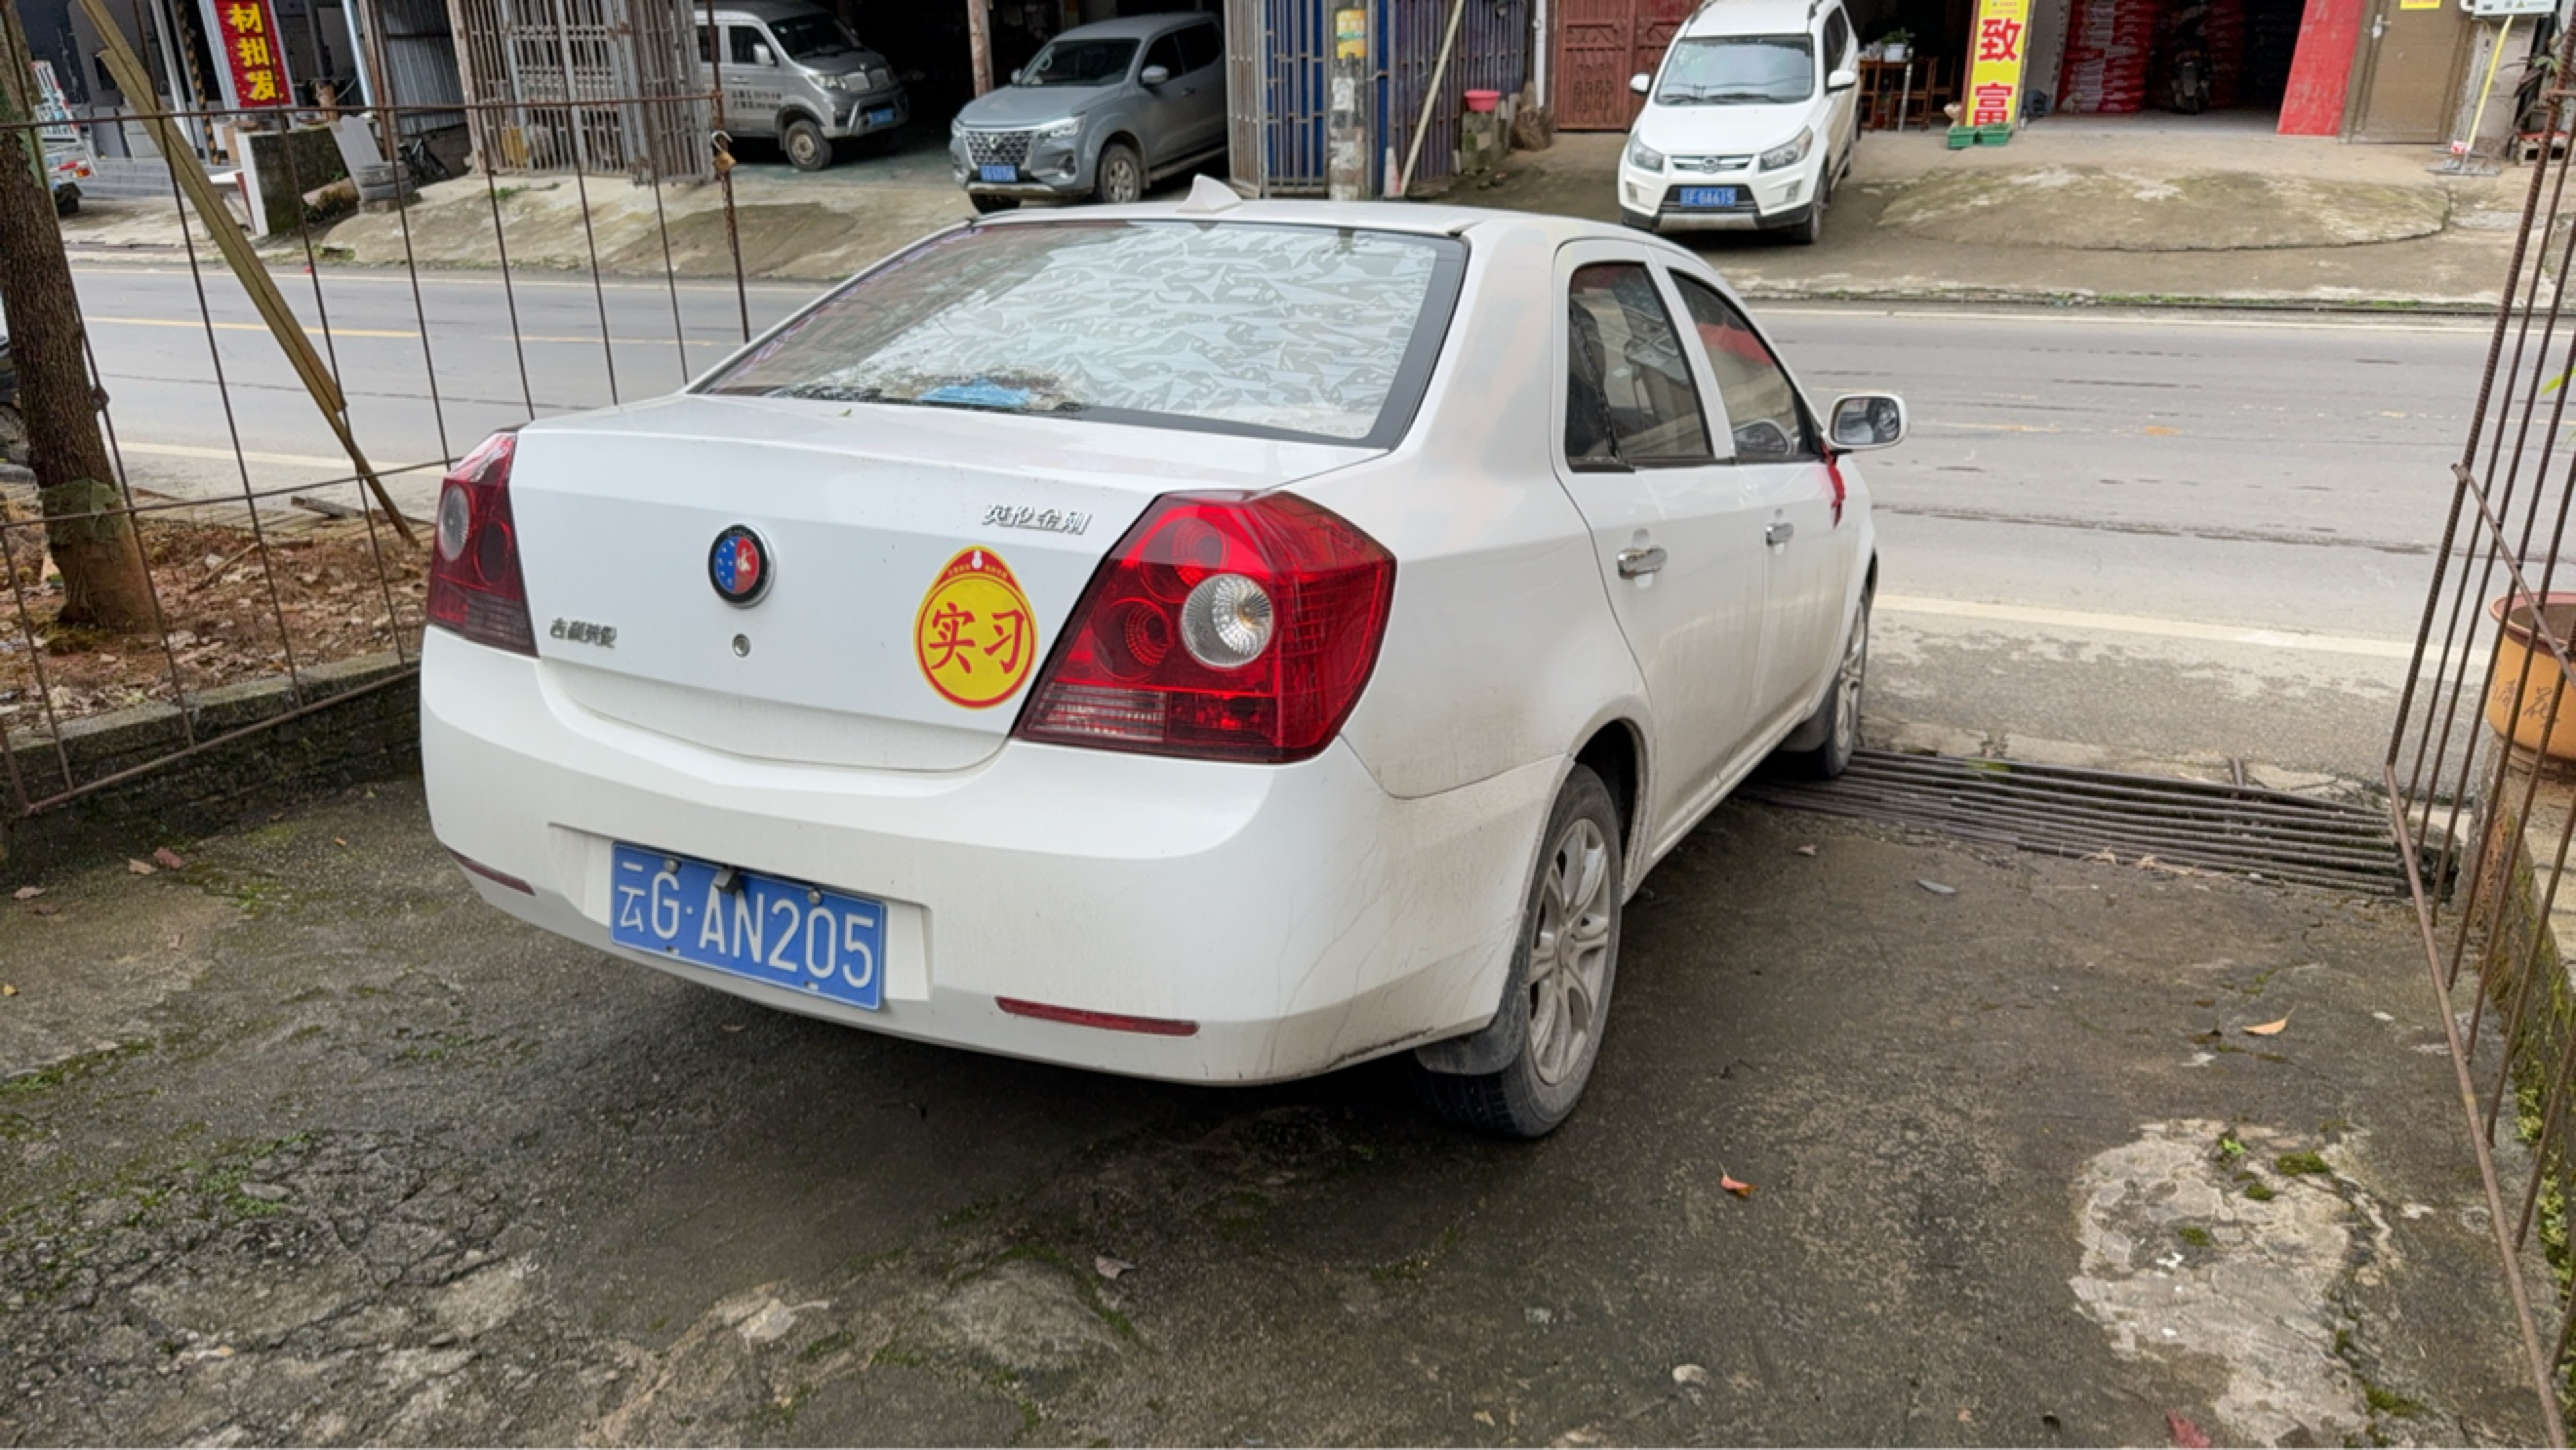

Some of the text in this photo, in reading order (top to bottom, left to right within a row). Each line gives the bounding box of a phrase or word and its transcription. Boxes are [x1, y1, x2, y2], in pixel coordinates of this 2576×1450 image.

[226, 2, 276, 101] 材批发
[1973, 17, 2023, 126] 致富
[928, 600, 1026, 674] 实习
[618, 861, 875, 988] 云G·AN205
